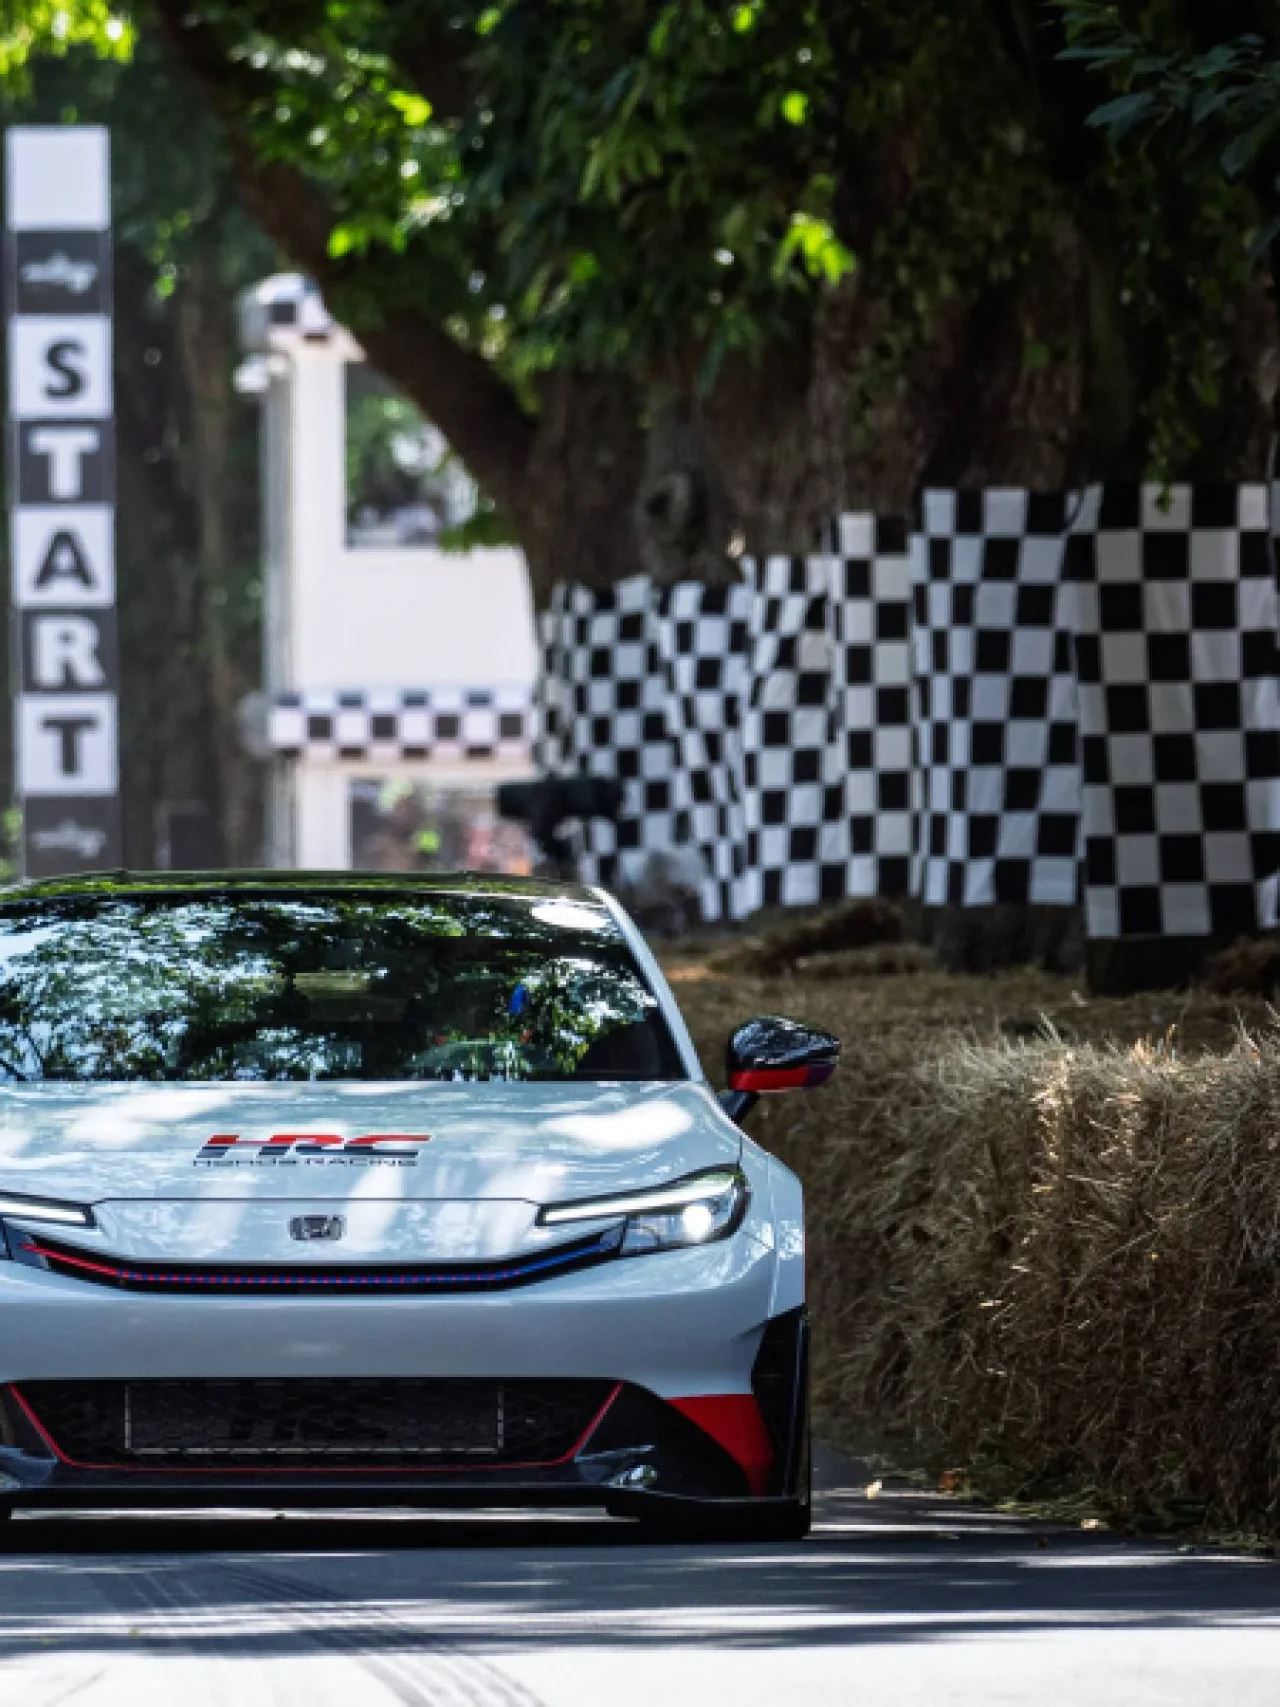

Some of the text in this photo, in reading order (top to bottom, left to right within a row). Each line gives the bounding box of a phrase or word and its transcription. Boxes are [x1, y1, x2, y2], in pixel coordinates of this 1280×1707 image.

[28, 340, 105, 776] START
[195, 1133, 432, 1158] HRC
[306, 1157, 418, 1167] RACING
